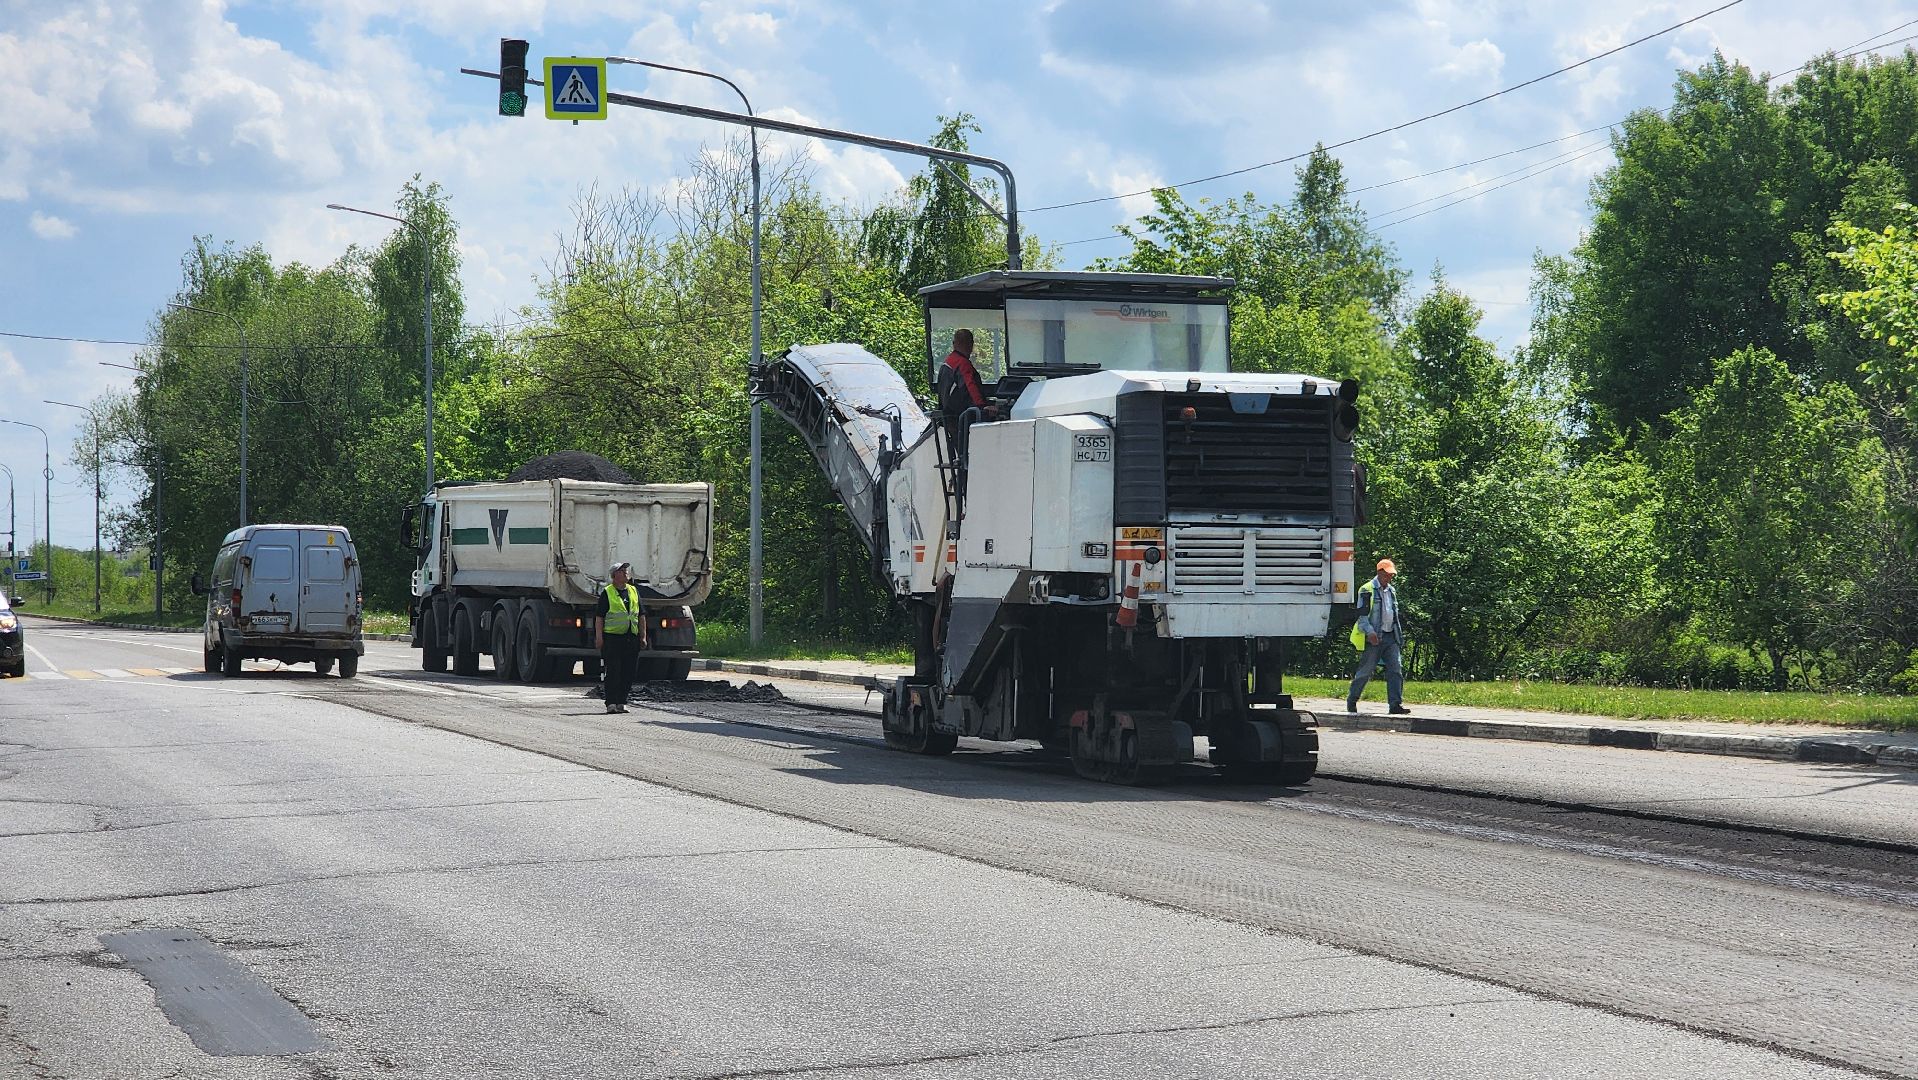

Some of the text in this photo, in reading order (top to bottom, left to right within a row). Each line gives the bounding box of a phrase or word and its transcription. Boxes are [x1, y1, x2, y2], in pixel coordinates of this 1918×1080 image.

[1133, 308, 1168, 318] Wirtgen
[1079, 436, 1106, 448] 9365
[1077, 451, 1108, 460] НС 77
